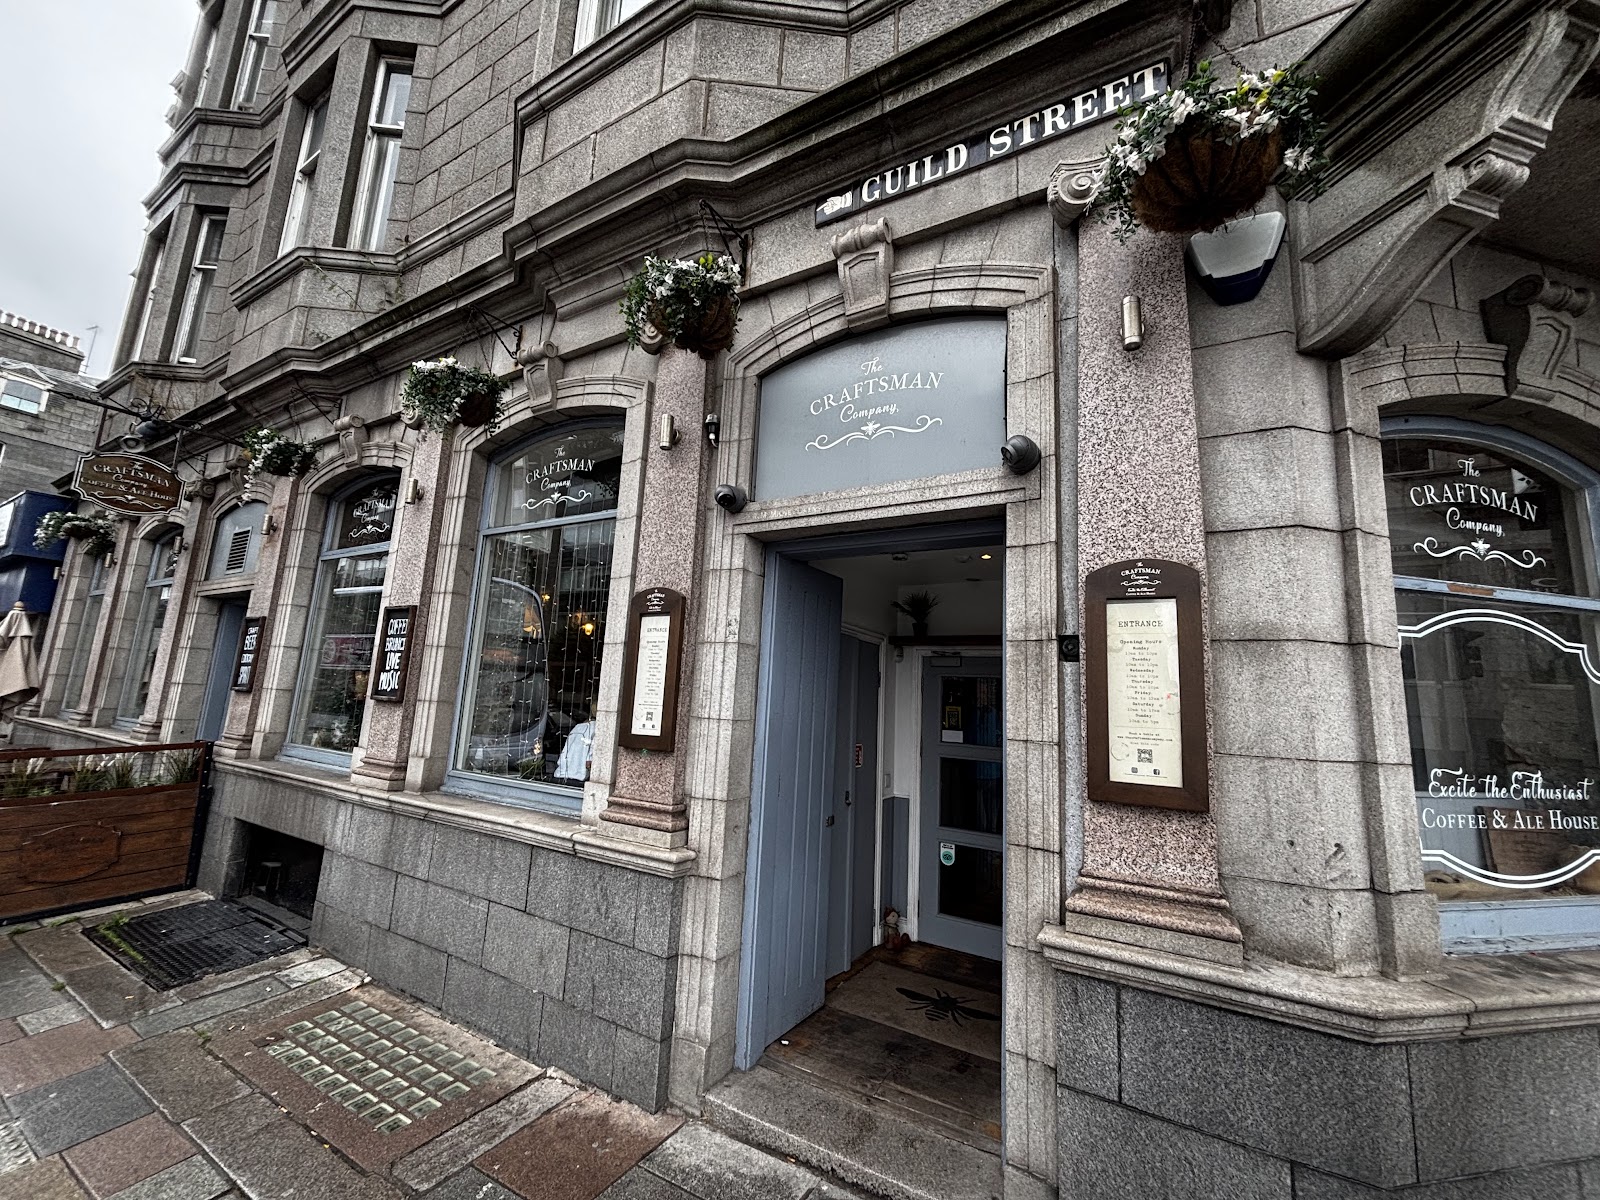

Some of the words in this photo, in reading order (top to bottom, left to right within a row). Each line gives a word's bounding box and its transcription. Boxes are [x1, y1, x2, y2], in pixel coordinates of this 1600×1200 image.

[861, 143, 968, 203] GUILD
[989, 61, 1166, 158] STREET
[860, 356, 884, 376] The
[809, 371, 945, 416] CRAFTSMAN
[93, 464, 171, 487] CRAFTSMAN
[525, 458, 596, 484] CRAFTSMAN
[1457, 457, 1481, 478] The
[1409, 483, 1538, 523] CRAFTSMAN
[1120, 567, 1162, 577] CRAFTSMAN
[1118, 620, 1164, 628] ENTRANCE
[385, 652, 402, 671] LIVE
[378, 670, 401, 692] MUSIC
[1428, 766, 1477, 798] Excite
[1478, 774, 1509, 799] the
[1509, 769, 1595, 801] Enthusiast
[1492, 808, 1509, 830] &
